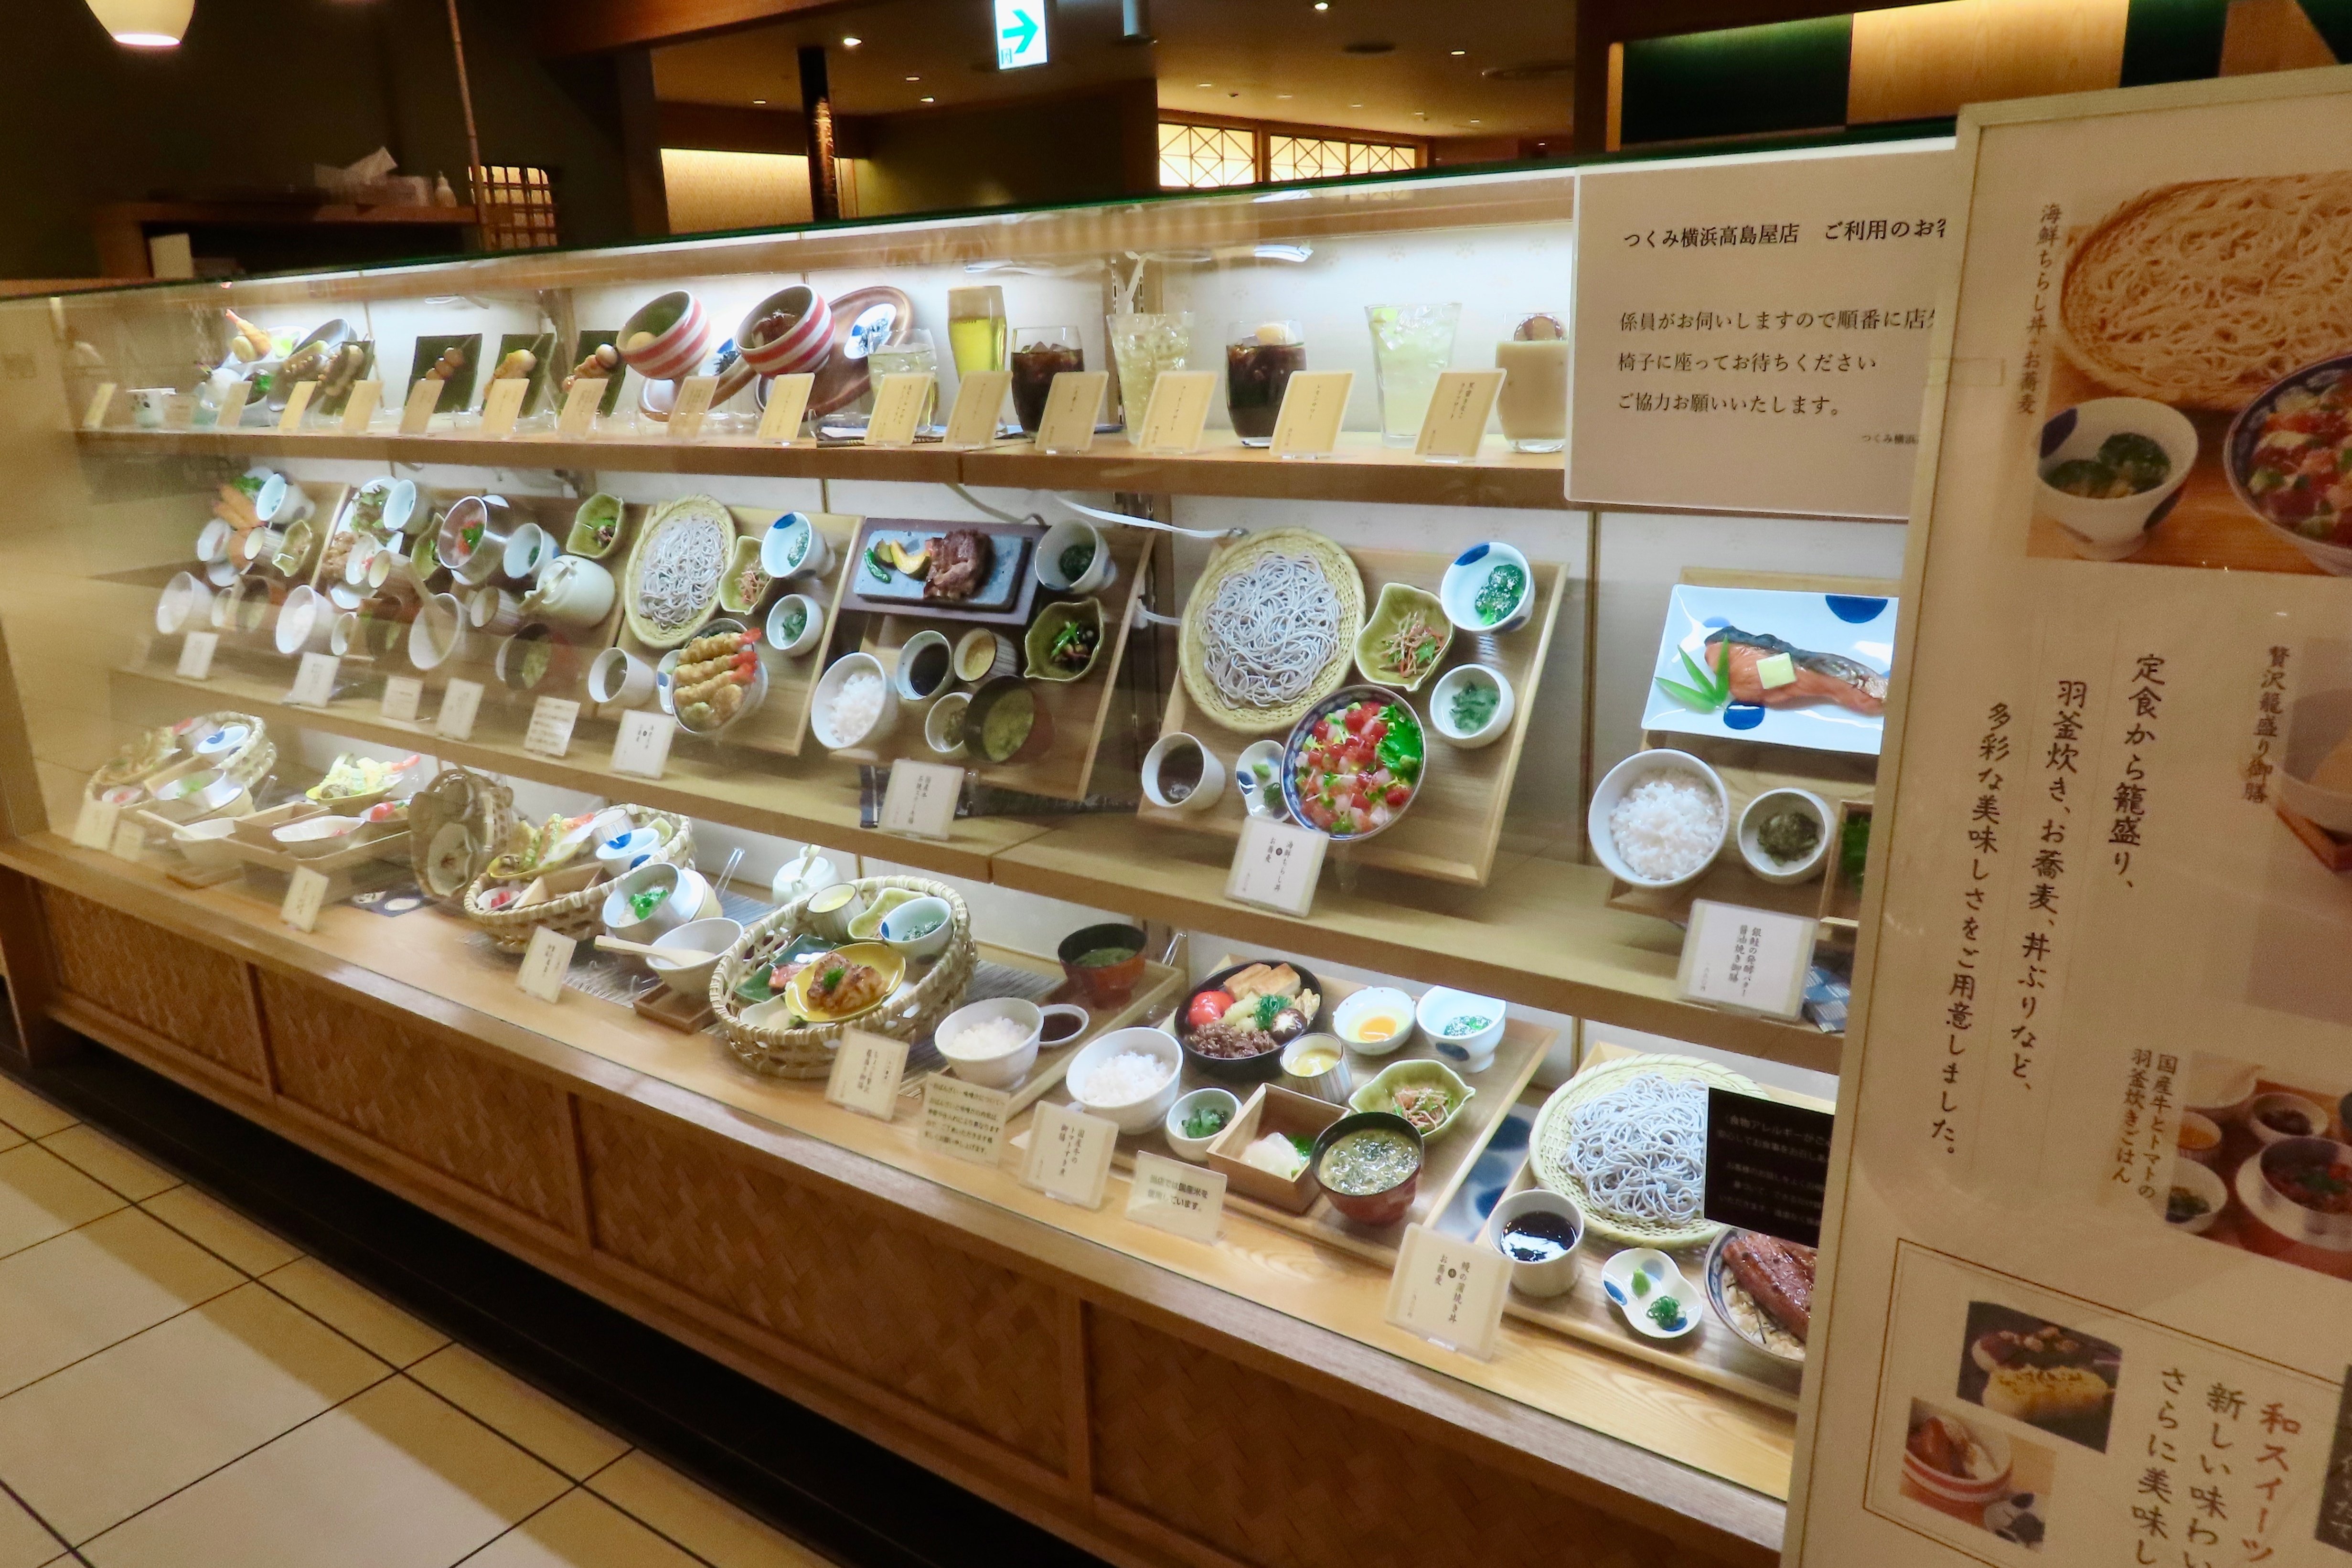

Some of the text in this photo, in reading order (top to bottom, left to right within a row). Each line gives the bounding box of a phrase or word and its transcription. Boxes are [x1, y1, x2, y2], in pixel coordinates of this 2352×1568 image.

[1618, 352, 1876, 373] 椅子に座ってお待ちください
[1618, 393, 1840, 417] ご協力お願いいたします。
[2108, 653, 2166, 889] 定食から籠盛り、
[1274, 841, 1294, 891] 海鮮ちらし丼
[1931, 702, 2010, 1155] 多彩な美味しさをご用意しました。
[2010, 681, 2087, 1091] 羽釜炊き、お蕎麦、丼ぶりなど、
[2112, 1048, 2152, 1184] 羽釜炊きごはん
[2138, 1054, 2178, 1198] 国産牛とトマトの
[2131, 1366, 2186, 1565] さらに美味し
[2241, 1402, 2302, 1563] 和スイーツ
